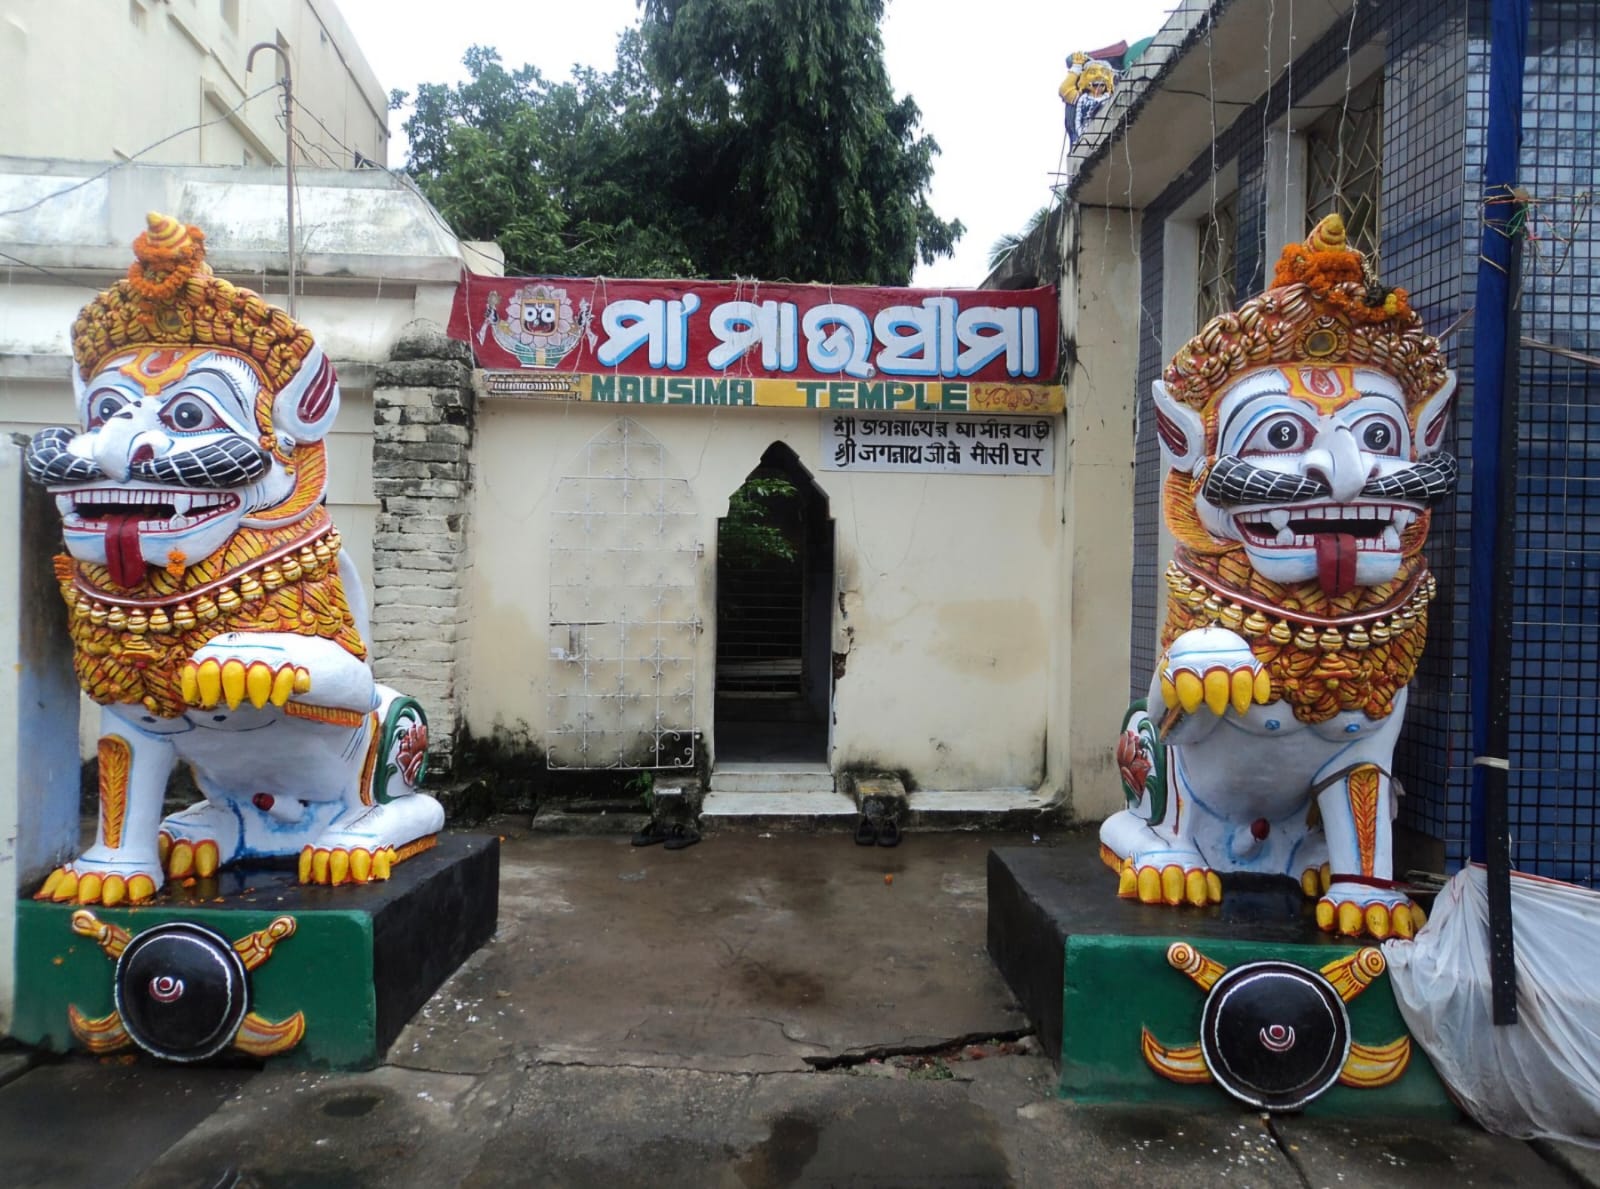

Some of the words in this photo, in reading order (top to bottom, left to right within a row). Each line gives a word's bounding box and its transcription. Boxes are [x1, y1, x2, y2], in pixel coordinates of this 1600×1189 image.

[591, 376, 753, 405] MAUSIMA
[799, 380, 968, 410] TEMPLE
[834, 438, 857, 467] श्री
[969, 441, 1009, 465] मौसी
[1012, 447, 1045, 466] घर
